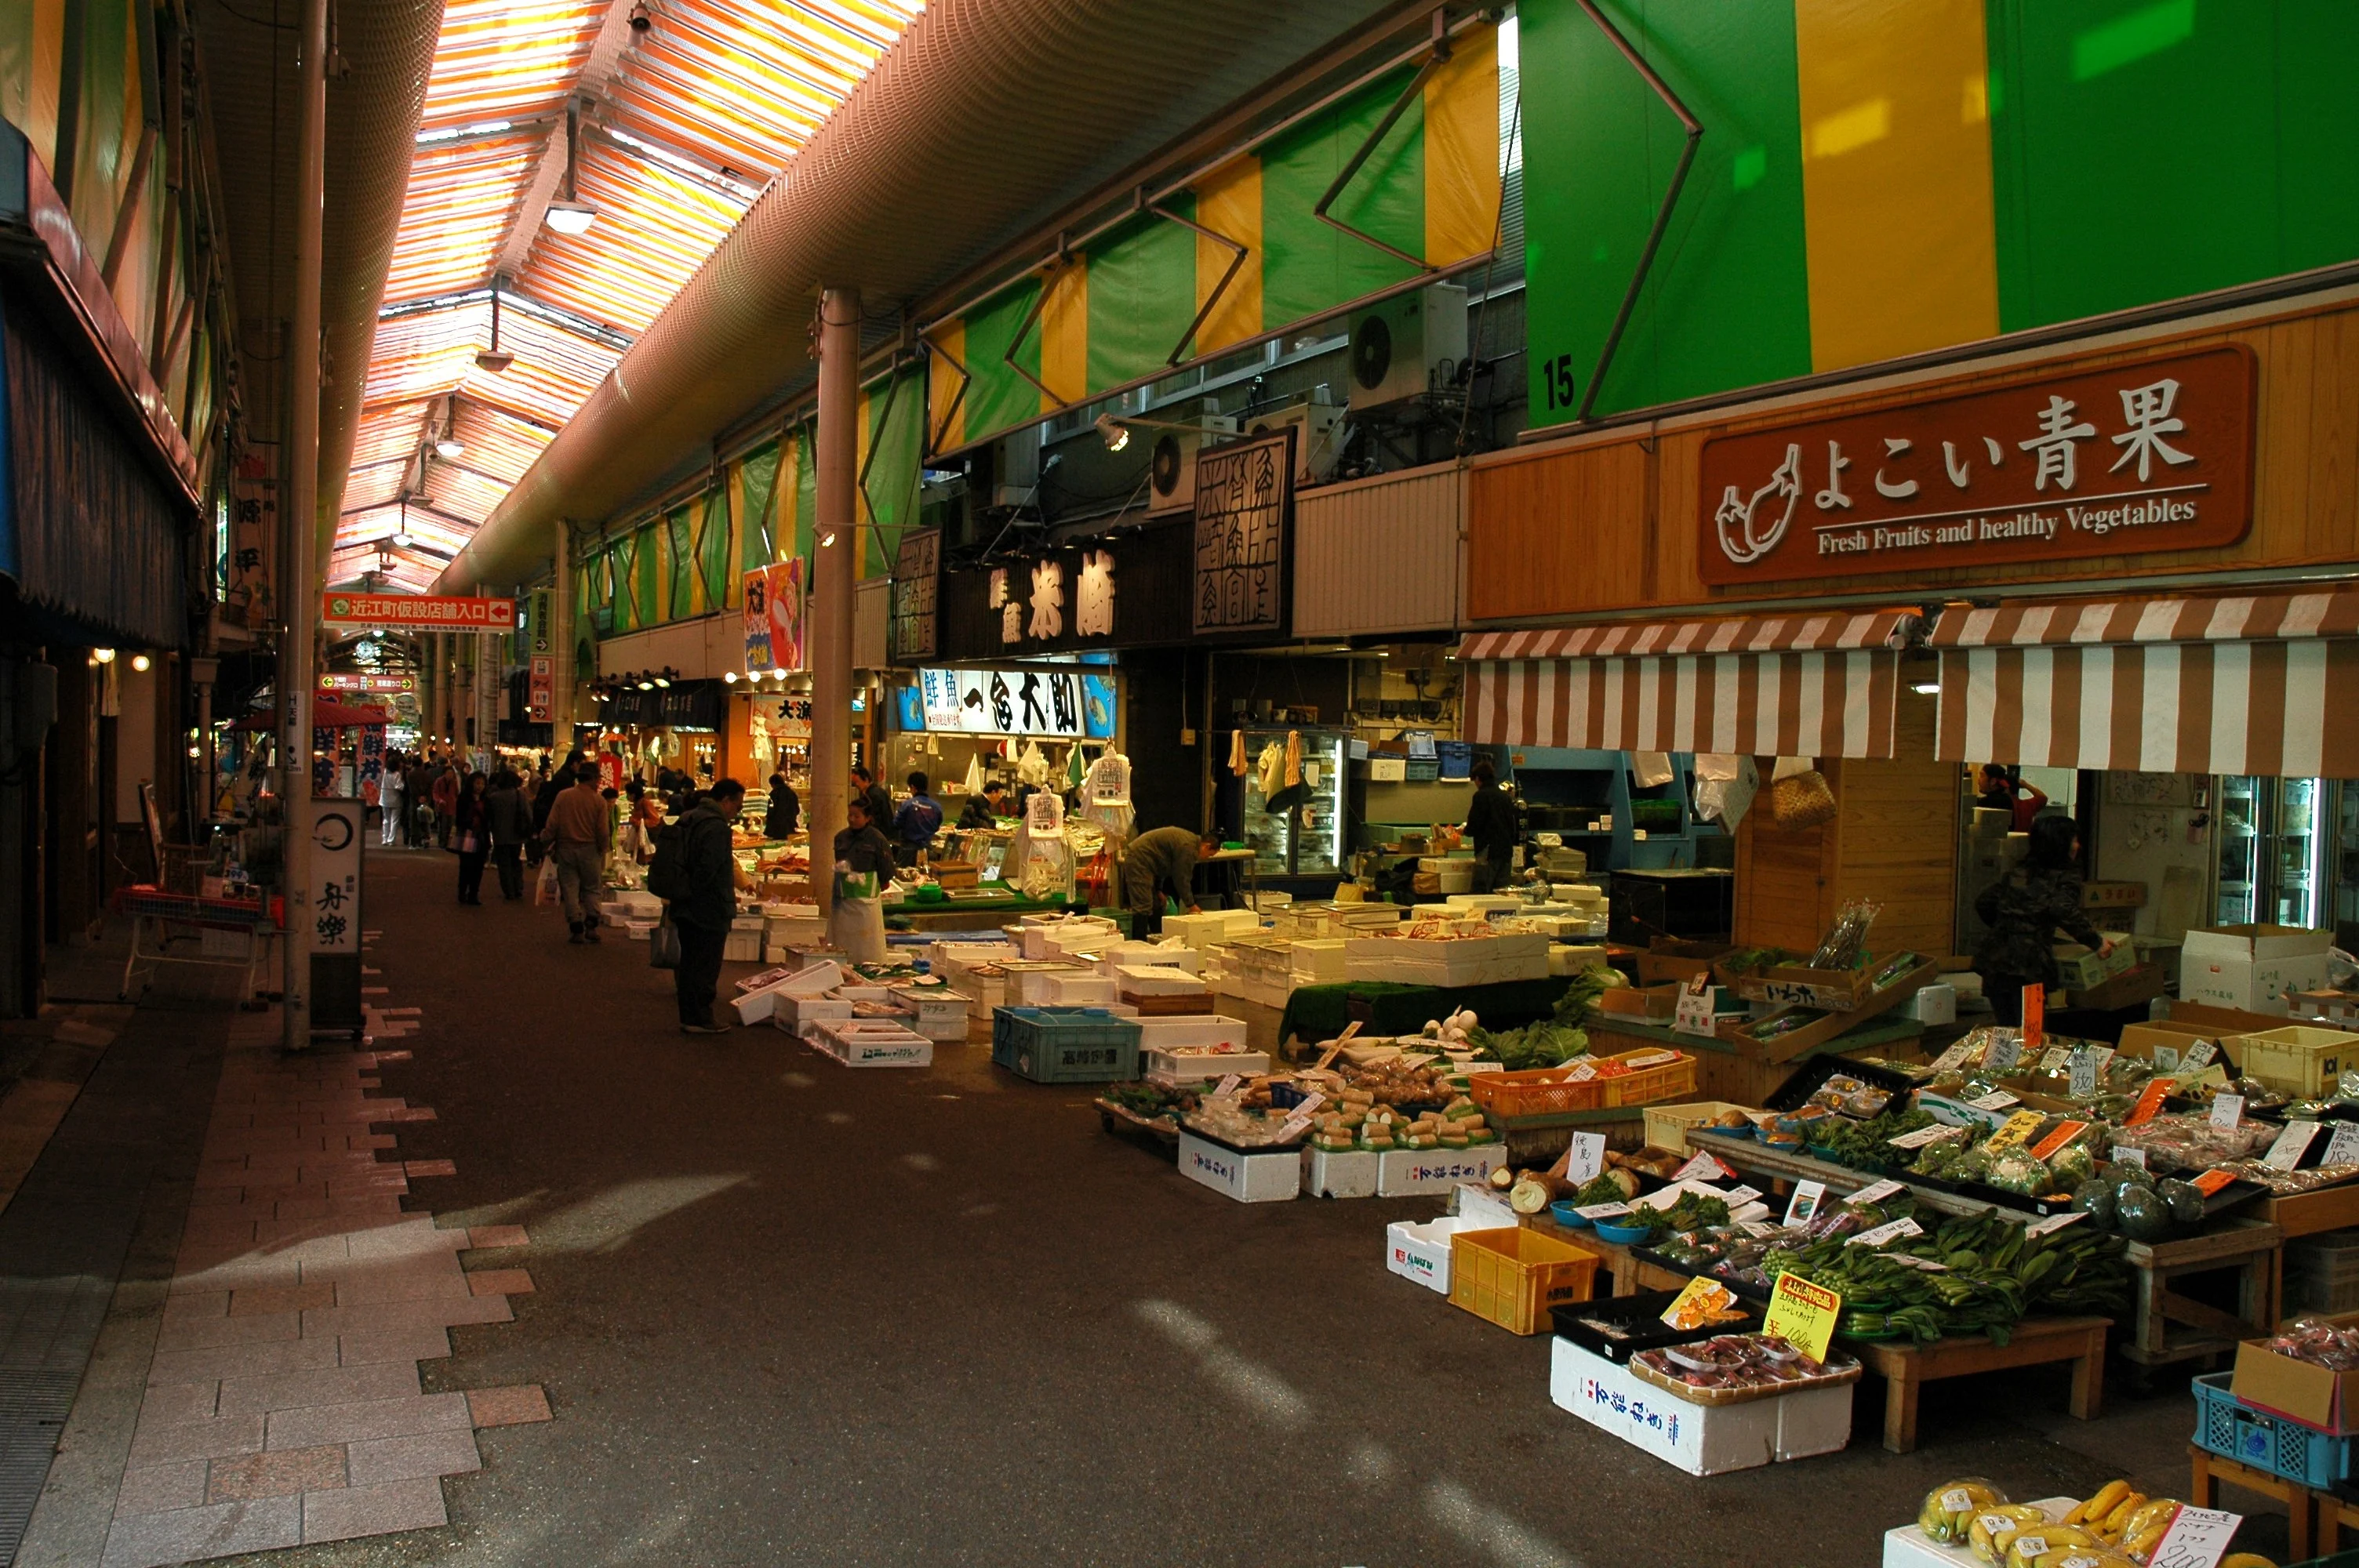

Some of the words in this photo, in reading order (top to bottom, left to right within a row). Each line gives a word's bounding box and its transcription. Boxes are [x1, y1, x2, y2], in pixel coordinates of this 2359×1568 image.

[1543, 353, 1574, 410] 15
[1815, 379, 2195, 510] よこい青果
[1818, 532, 1867, 555] Fresh
[1873, 524, 1931, 550] Fruits
[1935, 519, 1973, 544] and
[1979, 514, 2059, 541] healthy
[2065, 499, 2196, 535] Vegetables
[351, 599, 485, 619] 近江町仮設店舗入口
[1766, 983, 1816, 1007] いわた
[2073, 1072, 2092, 1090] 550
[1595, 1381, 1663, 1430] 万能ねぎ
